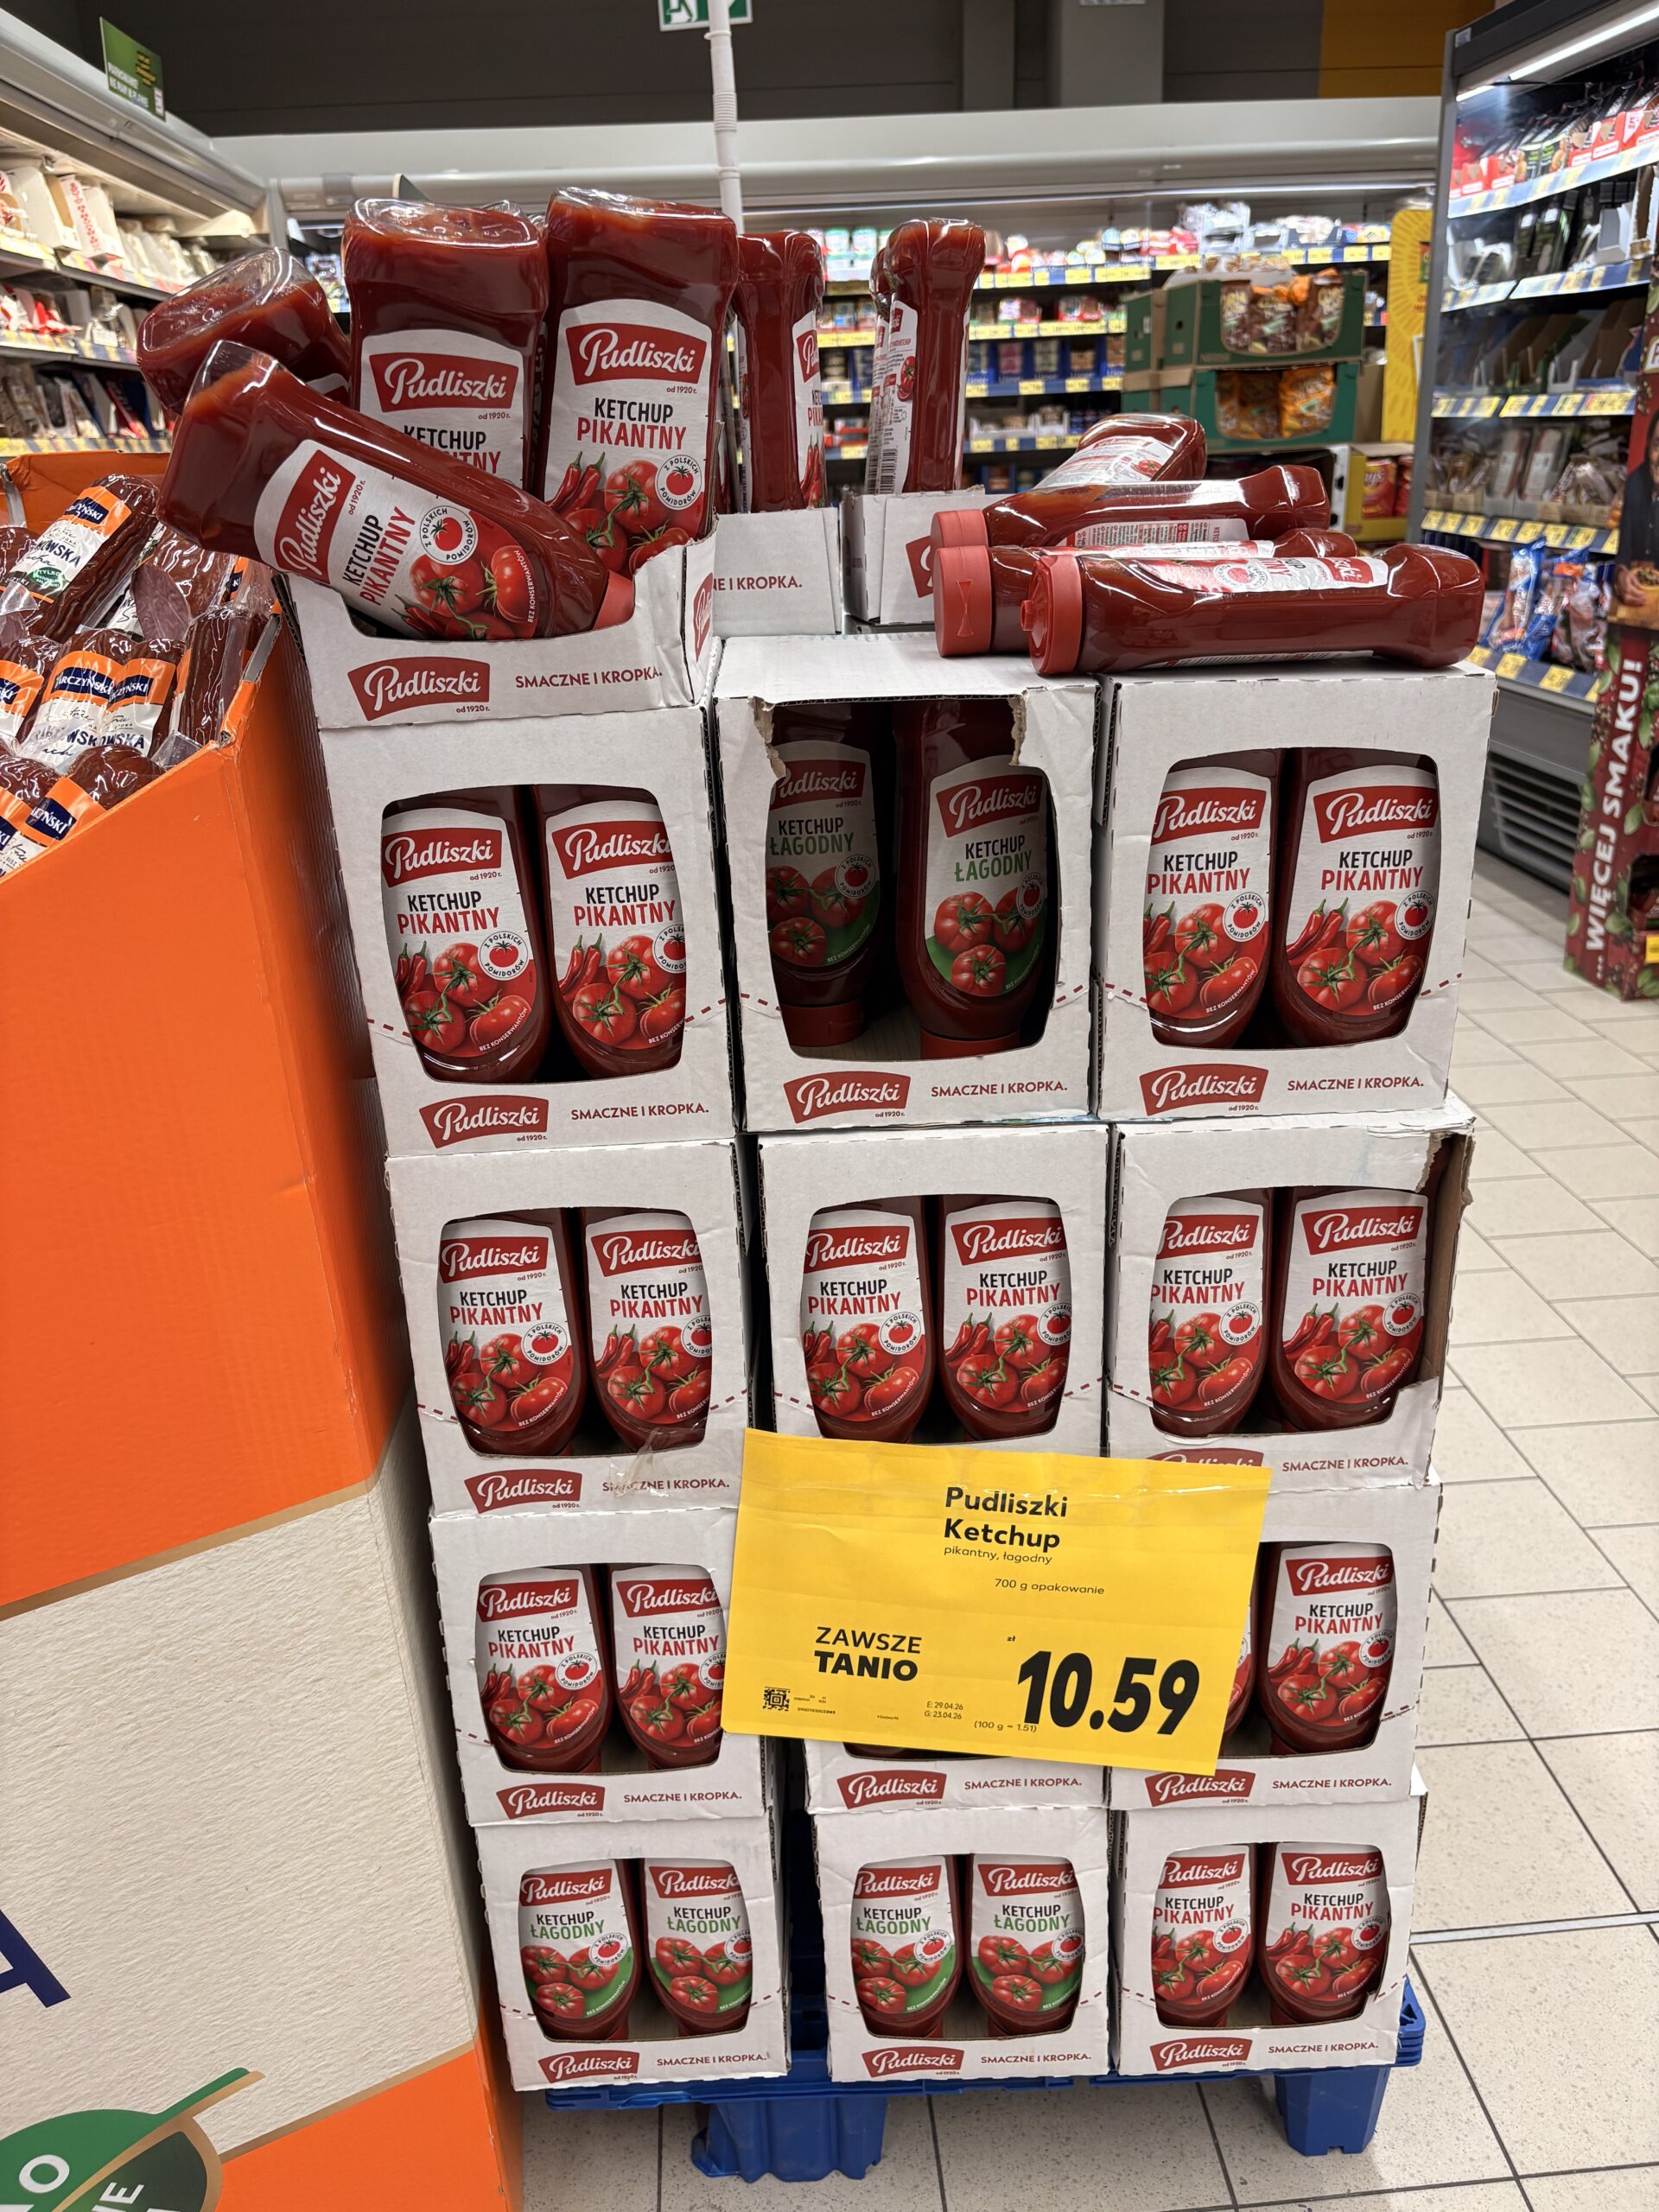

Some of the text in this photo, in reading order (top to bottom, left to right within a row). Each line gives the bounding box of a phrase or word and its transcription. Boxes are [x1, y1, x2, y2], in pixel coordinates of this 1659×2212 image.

[579, 328, 696, 377] Pudliszki
[385, 358, 507, 404] Pudliszki
[594, 397, 673, 423] KETCHUP
[577, 417, 686, 450] PIKANTNY
[670, 456, 698, 474] POLSKICH
[659, 487, 696, 506] POMIDORÓW
[280, 467, 340, 575] Pudliszki
[342, 514, 383, 586] KETCHUP
[360, 506, 416, 605] PIKANTNY
[364, 665, 480, 711] Pudliszki
[516, 674, 590, 689] SMACZNE
[602, 668, 662, 683] KROPKA.
[949, 785, 1036, 828] Pudliszki
[1326, 793, 1433, 835] Pudliszki
[1586, 825, 1617, 950] WIĘCEJ
[1603, 658, 1643, 819] SMAKU!
[779, 817, 843, 836] KETCHUP
[1154, 796, 1257, 837] Pudliszki
[771, 833, 854, 855] ŁAGODNY
[966, 835, 1025, 859] KETCHUP
[385, 836, 493, 879] Pudliszki
[955, 850, 1032, 883] ŁAGODNY
[1164, 851, 1237, 872] KETCHUP
[1339, 849, 1412, 868] KETCHUP
[1147, 868, 1250, 894] PIKANTNY
[1321, 867, 1423, 891] PIKANTNY
[408, 891, 481, 912] KETCHUP
[586, 884, 659, 904] KETCHUP
[397, 907, 499, 933] PIKANTNY
[574, 900, 676, 926] PIKANTNY
[931, 1084, 997, 1097] SMACZNE
[1008, 1081, 1067, 1094] KROPKA.
[1152, 1071, 1256, 1108] Pudliszki
[1287, 1078, 1354, 1090] SMACZNE
[1364, 1077, 1424, 1088] KROPKA.
[797, 1078, 899, 1116] Pudliszki
[434, 1103, 539, 1141] Pudliszki
[571, 1107, 638, 1120] SMACZNE
[649, 1103, 709, 1116] KROPKA.
[963, 1224, 1062, 1259] Pudliszki
[1313, 1213, 1414, 1249] Pudliszki
[442, 1243, 539, 1277] Pudliszki
[808, 1233, 900, 1267] Pudliszki
[980, 1270, 1047, 1287] KETCHUP
[1164, 1268, 1232, 1285] KETCHUP
[1328, 1261, 1396, 1277] KETCHUP
[620, 1282, 688, 1299] KETCHUP
[821, 1279, 887, 1296] KETCHUP
[967, 1282, 1060, 1306] PIKANTNY
[1151, 1281, 1244, 1304] PIKANTNY
[1313, 1273, 1408, 1297] PIKANTNY
[460, 1289, 527, 1306] KETCHUP
[610, 1294, 702, 1318] PIKANTNY
[808, 1292, 900, 1315] PIKANTNY
[450, 1302, 543, 1325] PIKANTNY
[1282, 1460, 1344, 1472] SMACZNE
[1354, 1456, 1408, 1468] KROPKA.
[478, 1475, 573, 1507] Pudliszki
[945, 1487, 1068, 1517] Pudliszki
[944, 1518, 1059, 1553] Ketchup
[944, 1546, 1052, 1565] pikantny, łagodny
[995, 1579, 1016, 1588] 700
[1032, 1583, 1104, 1594] opakowanie
[1296, 1561, 1389, 1591] Pudliszki
[480, 1587, 571, 1618] Pudliszki
[1309, 1603, 1373, 1618] KETCHUP
[498, 1626, 560, 1642] KETCHUP
[644, 1624, 705, 1640] KETCHUP
[1295, 1613, 1382, 1634] PIKANTNY
[489, 1636, 575, 1659] PIKANTNY
[632, 1636, 719, 1656] PIKANTNY
[816, 1626, 922, 1654] ZAWSZE
[814, 1650, 918, 1681] TANIO
[1017, 1650, 1199, 1735] 10.59
[849, 1776, 938, 1803] Pudliszki
[964, 1779, 1021, 1790] SMACZNE
[1031, 1778, 1082, 1787] KROPKA.
[1154, 1774, 1245, 1801] Pudliszki
[1272, 1780, 1330, 1789] SMACZNE
[1339, 1778, 1391, 1787] KROPKA.
[508, 1788, 597, 1814] Pudliszki
[624, 1793, 681, 1802] SMACZNE
[690, 1791, 741, 1801] KROPKA.
[988, 1867, 1074, 1892] Pudliszki
[1292, 1857, 1378, 1883] Pudliszki
[521, 1876, 605, 1902] Pudliszki
[855, 1871, 933, 1895] Pudliszki
[1002, 1904, 1061, 1918] KETCHUP
[1166, 1896, 1224, 1910] KETCHUP
[1290, 1902, 1373, 1920] PIKANTNY
[1304, 1893, 1363, 1905] KETCHUP
[537, 1911, 594, 1925] KETCHUP
[674, 1906, 731, 1919] KETCHUP
[864, 1907, 921, 1920] KETCHUP
[995, 1914, 1070, 1933] ŁAGODNY
[1154, 1904, 1234, 1924] PIKANTNY
[531, 1920, 604, 1940] ŁAGODNY
[667, 1916, 741, 1934] ŁAGODNY
[856, 1916, 931, 1935] ŁAGODNY
[1160, 2042, 1243, 2066] Pudliszki
[1268, 2044, 1322, 2054] SMACZNE
[1331, 2043, 1378, 2051] KROPKA.
[550, 2055, 632, 2079] Pudliszki
[872, 2050, 956, 2075] Pudliszki
